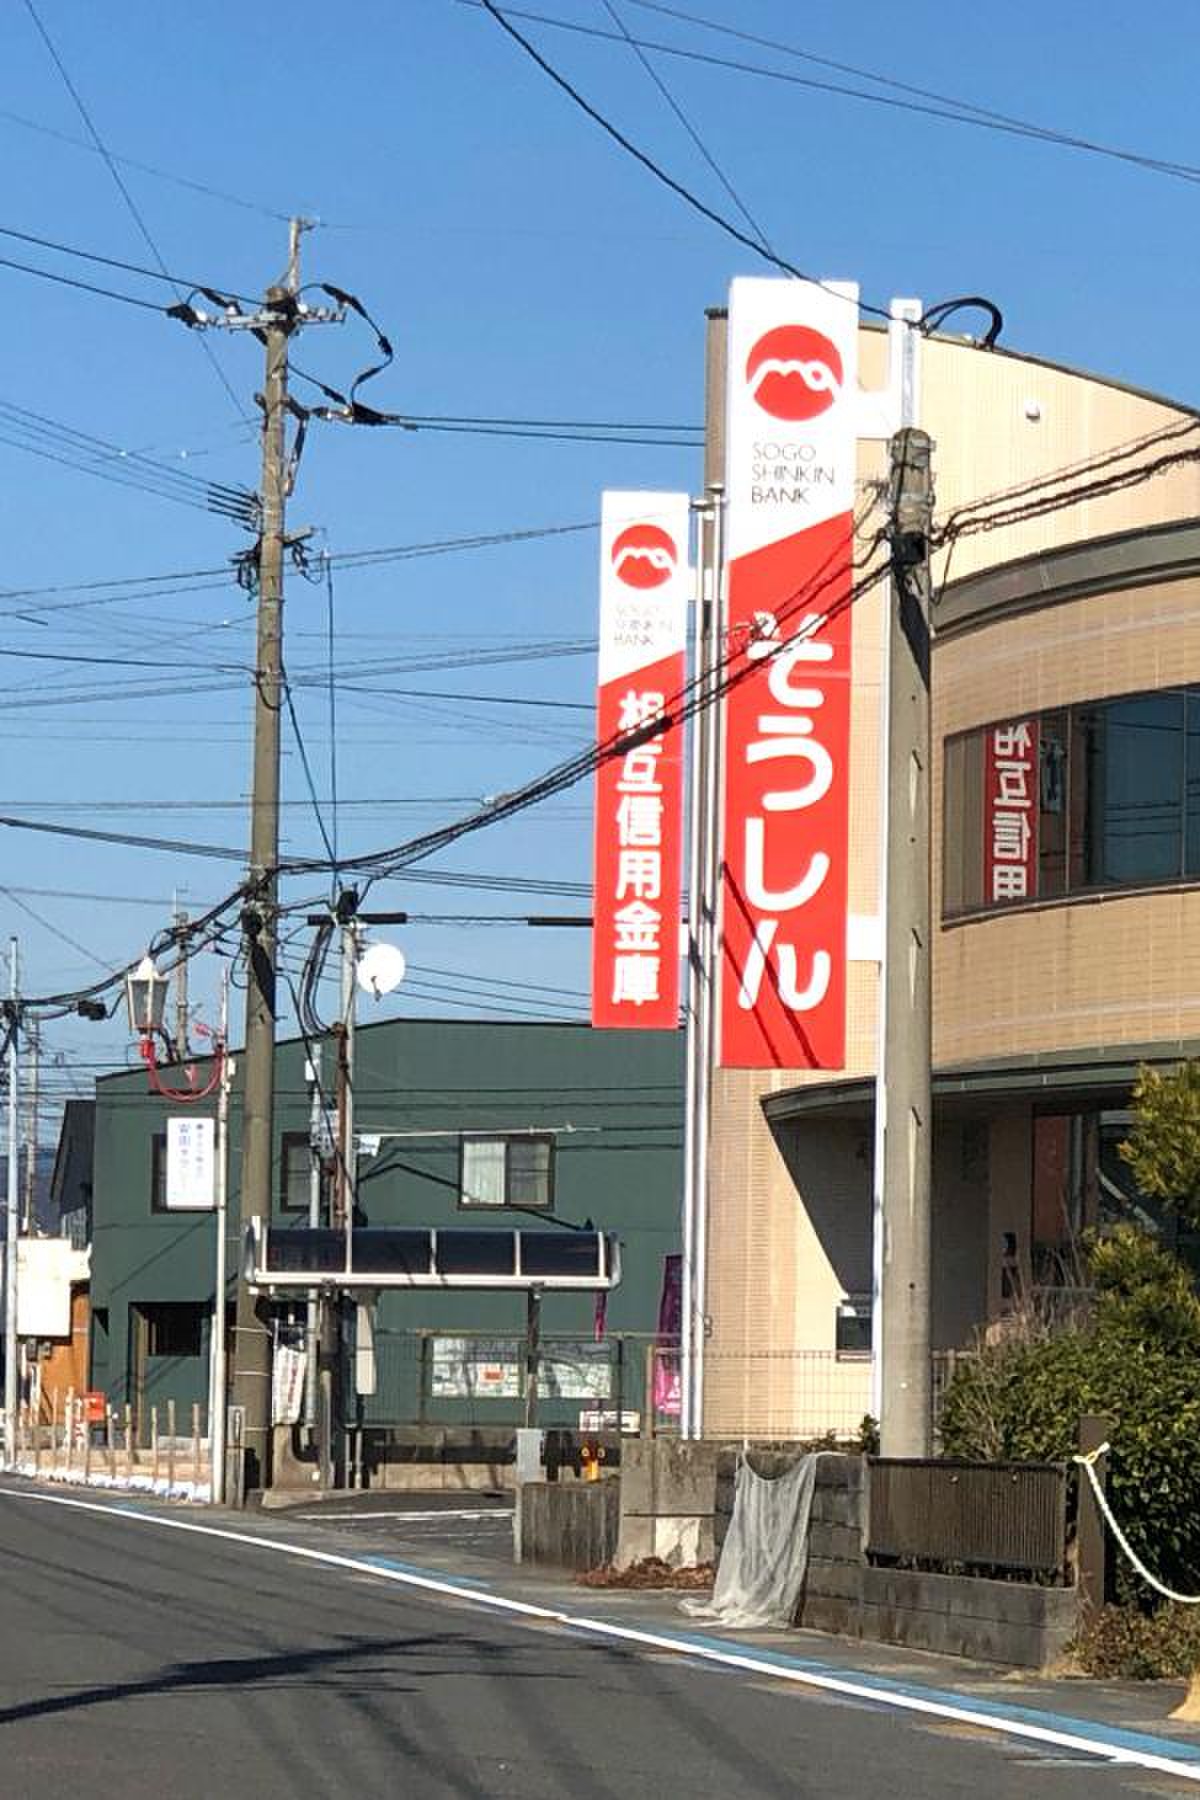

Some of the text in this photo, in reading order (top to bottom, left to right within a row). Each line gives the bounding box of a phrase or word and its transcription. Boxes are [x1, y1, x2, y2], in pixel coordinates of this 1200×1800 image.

[752, 441, 816, 462] SOGO
[752, 464, 835, 485] SHINKIN
[752, 486, 811, 505] BANK
[740, 612, 833, 1011] そうしん
